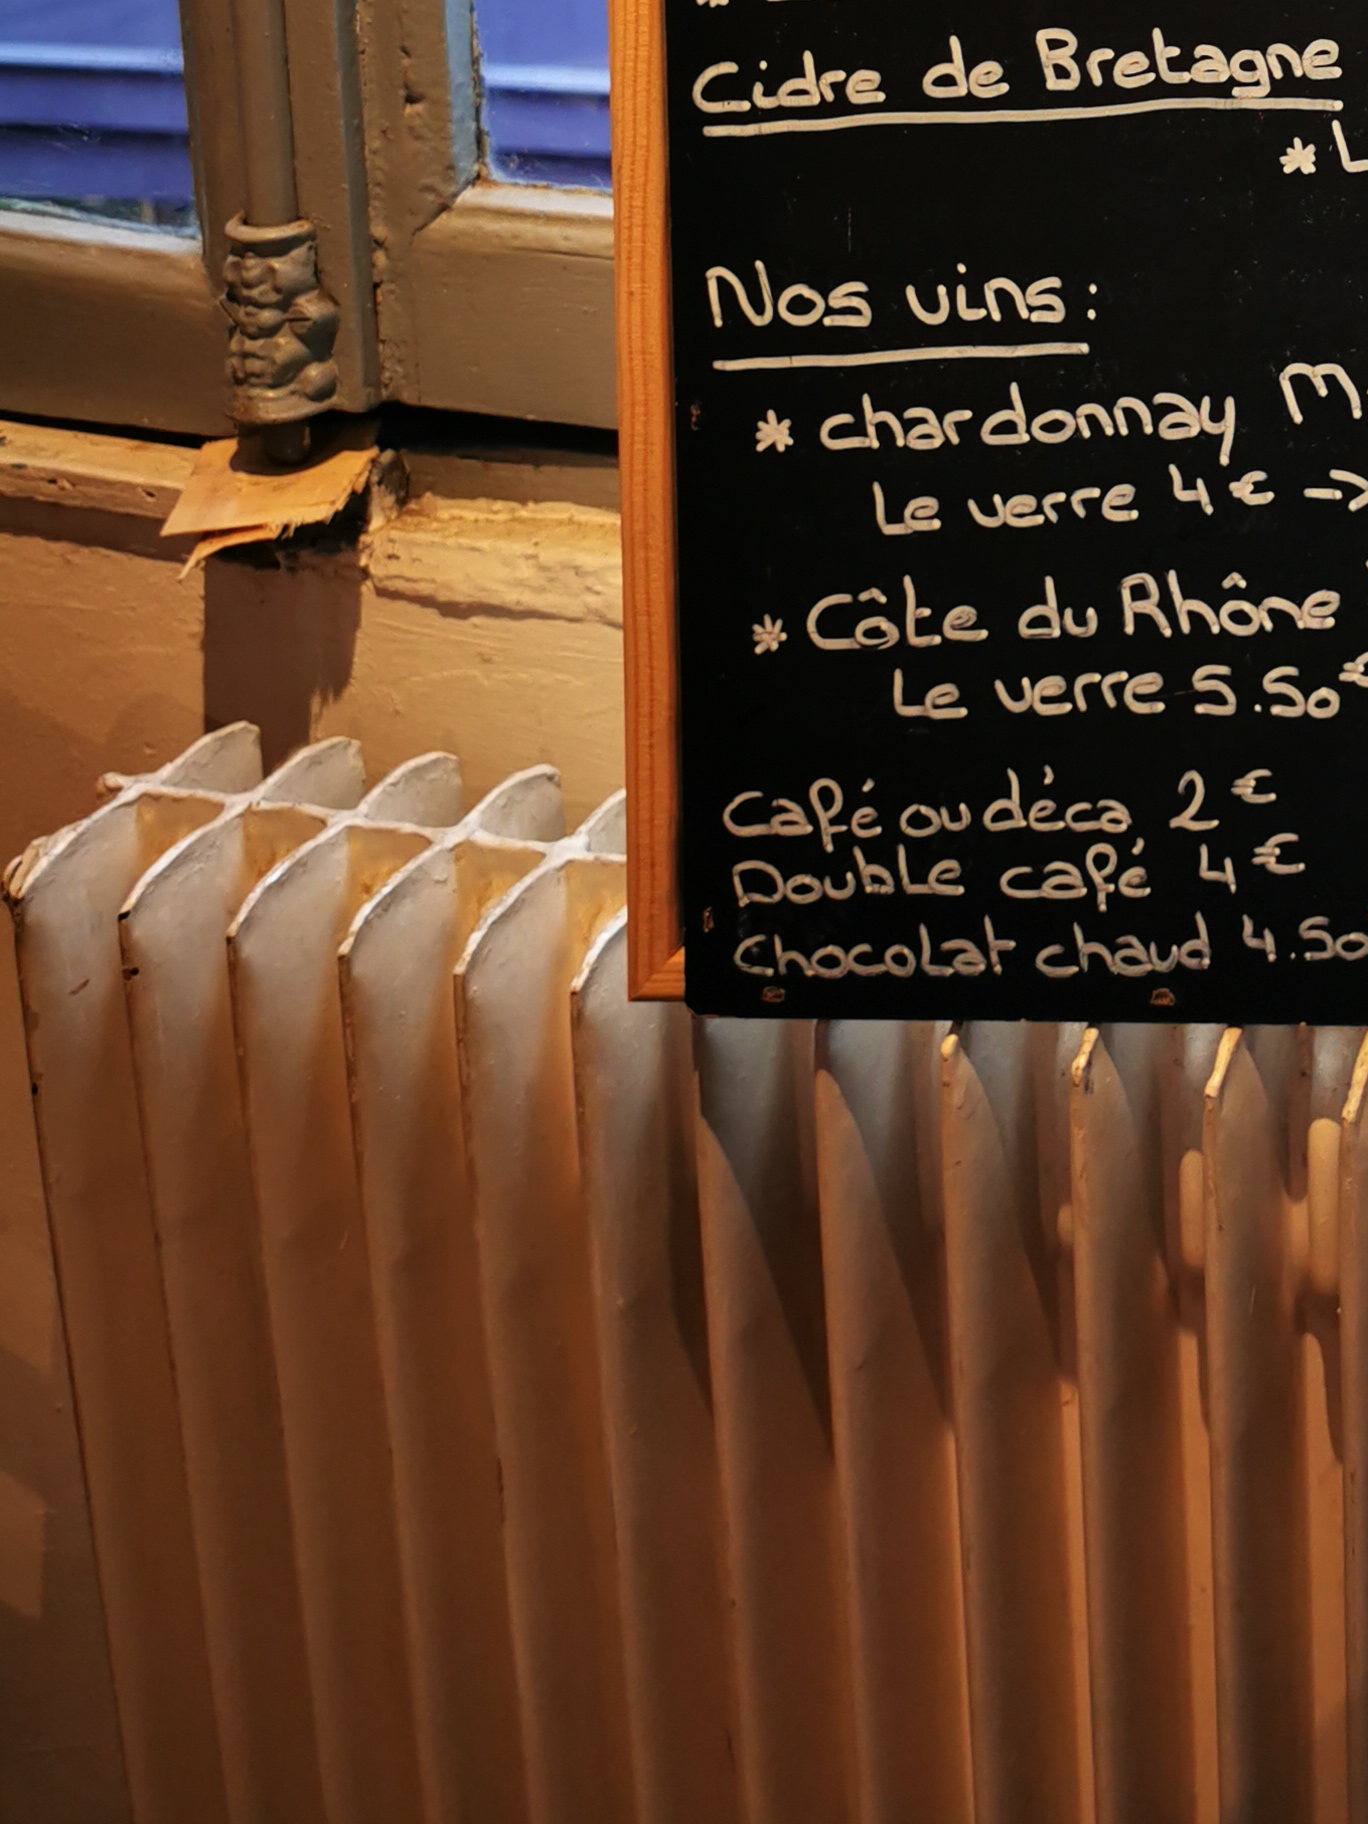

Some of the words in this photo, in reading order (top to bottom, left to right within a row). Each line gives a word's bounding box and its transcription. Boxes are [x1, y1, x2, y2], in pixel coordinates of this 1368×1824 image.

[693, 51, 886, 112] Cidre
[923, 36, 1009, 98] de
[1036, 28, 1342, 90] Bretagne
[706, 260, 871, 327] Nos
[873, 482, 941, 534] Le
[968, 484, 1138, 527] verre
[807, 575, 988, 649] Côte
[1019, 576, 1097, 637] du
[1121, 570, 1340, 637] Rhône
[894, 669, 967, 719] Le
[995, 671, 1165, 715] verre
[724, 779, 881, 852] Café
[901, 803, 970, 836] ou
[984, 766, 1131, 832] déca
[734, 845, 964, 902] Double
[1001, 839, 1150, 911] café
[1037, 913, 1208, 974] chaud
